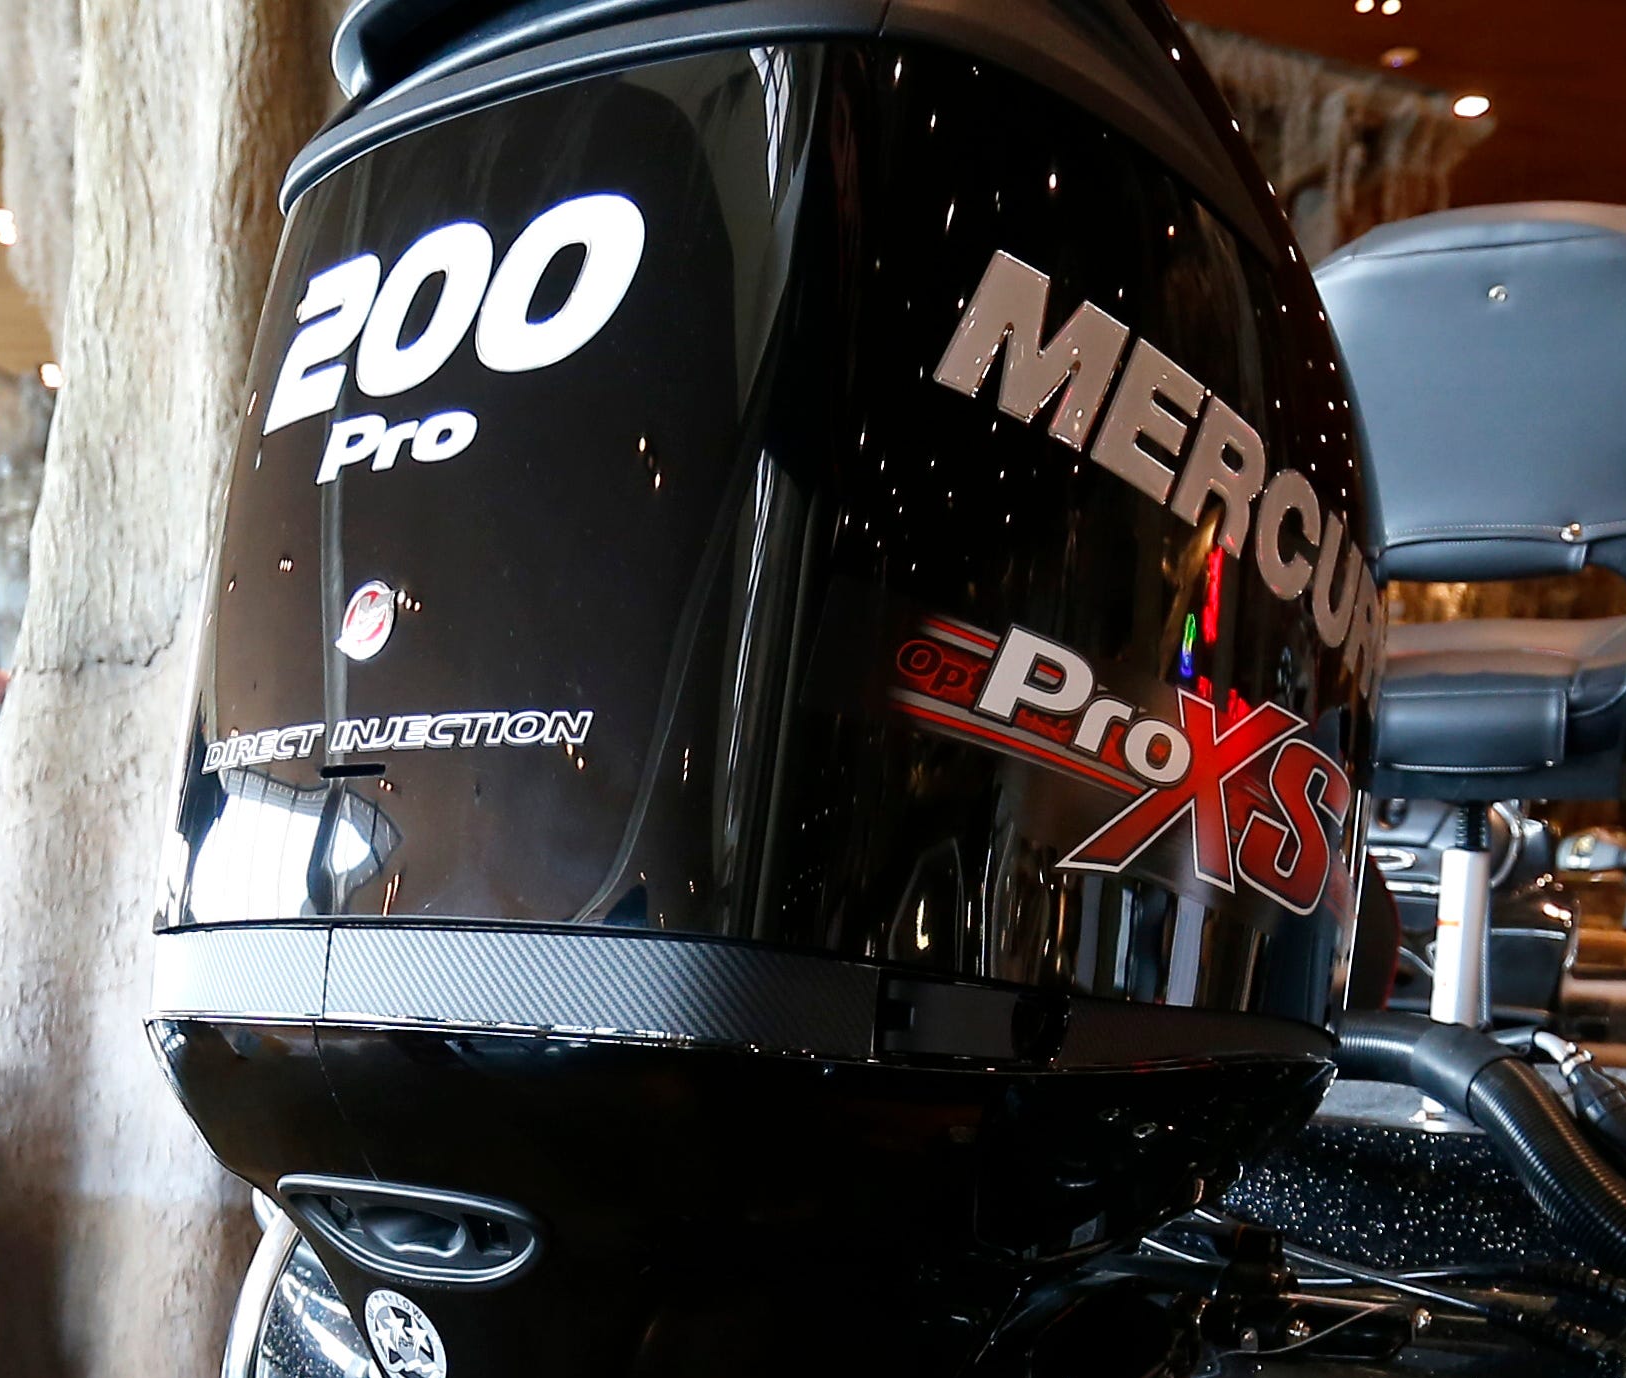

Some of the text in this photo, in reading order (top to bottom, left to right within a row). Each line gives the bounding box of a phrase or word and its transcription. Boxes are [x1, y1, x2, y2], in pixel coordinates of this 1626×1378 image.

[263, 191, 646, 437] 200
[315, 410, 479, 486] Pro
[933, 249, 1386, 721] MERCUR
[202, 710, 595, 775] DIRECT INJECTION
[978, 626, 1352, 915] Pro XS
